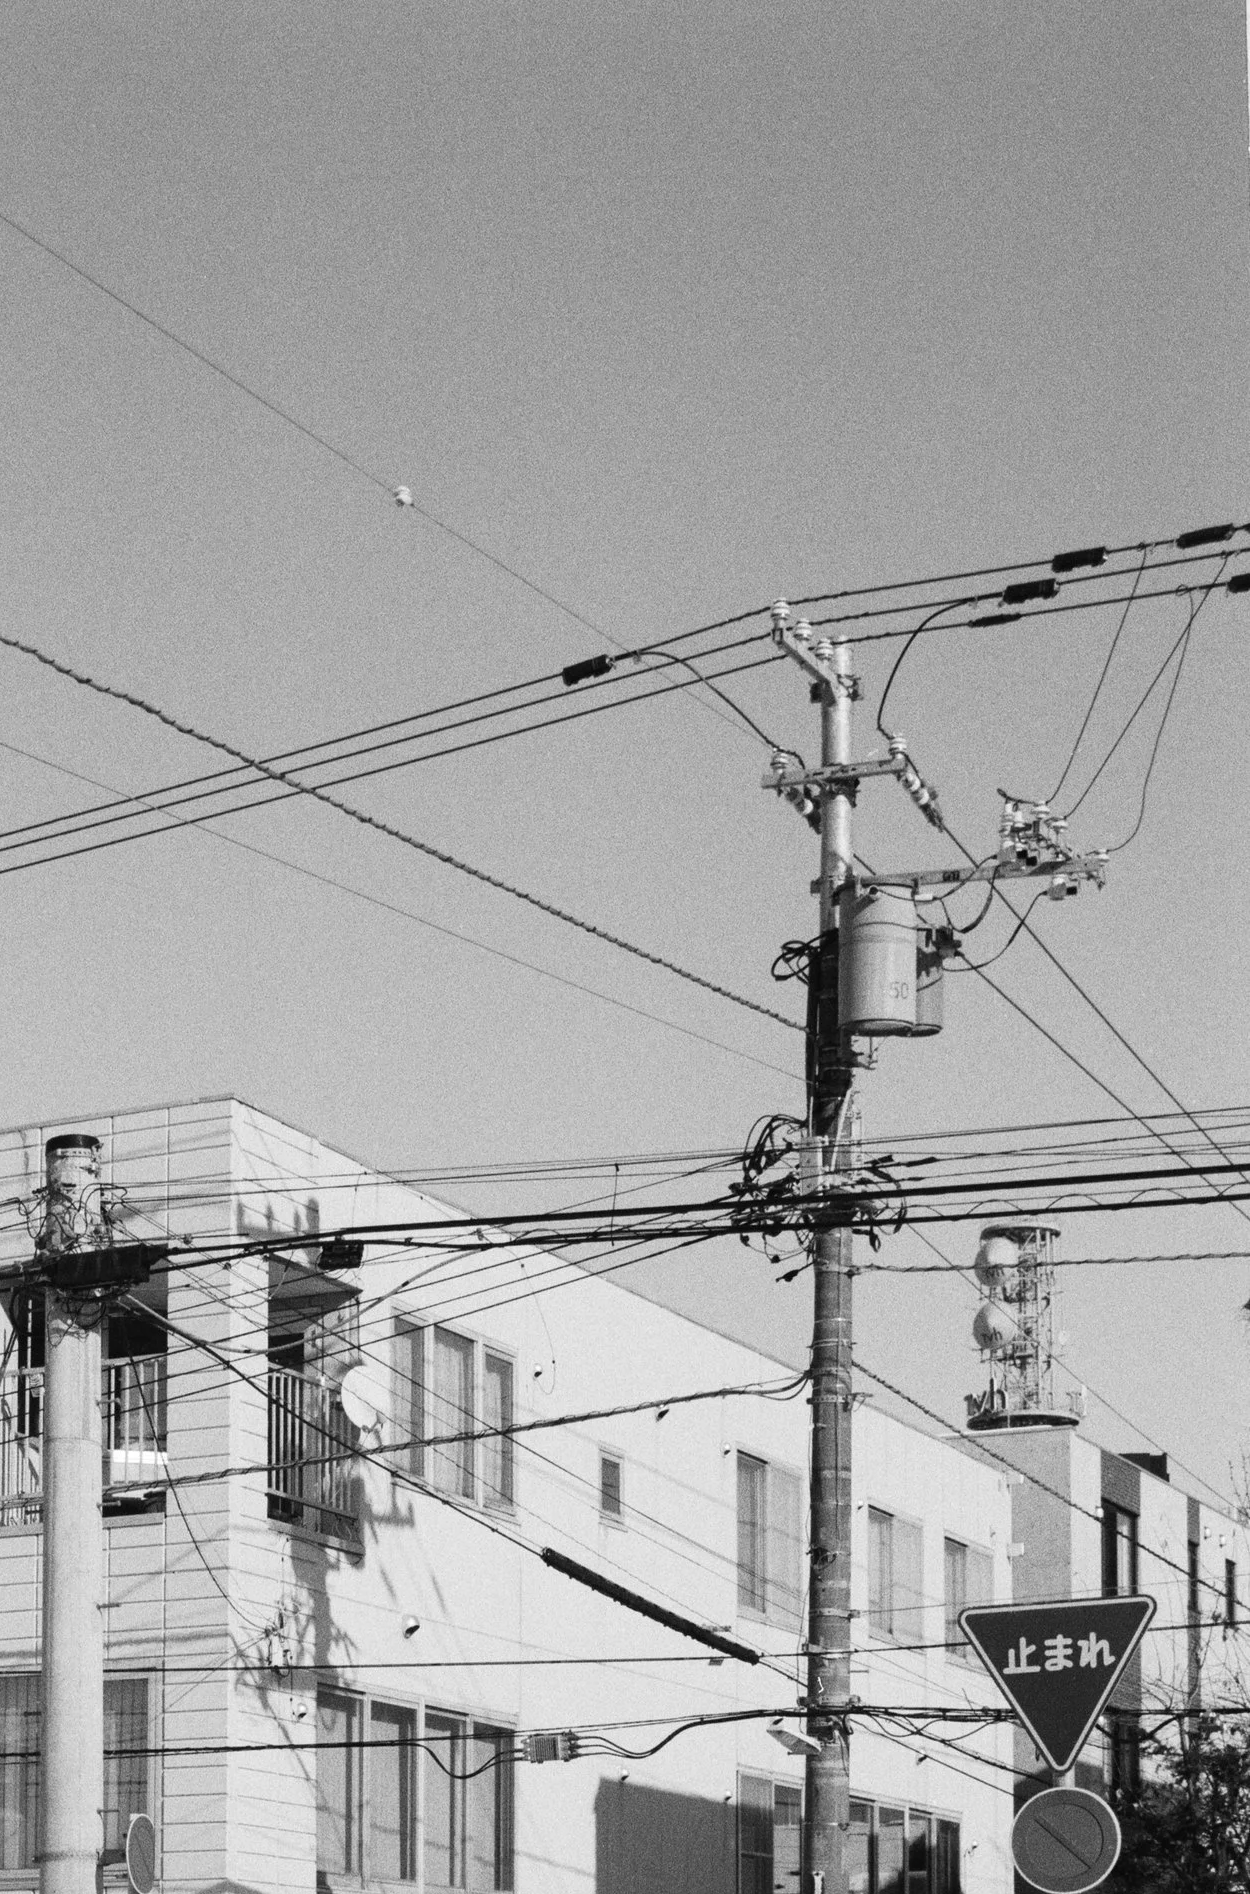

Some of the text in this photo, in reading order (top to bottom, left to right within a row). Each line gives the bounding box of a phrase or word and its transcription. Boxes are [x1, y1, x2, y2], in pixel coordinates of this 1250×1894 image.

[889, 980, 909, 999] 50
[1002, 1631, 1116, 1675] 止まれ
